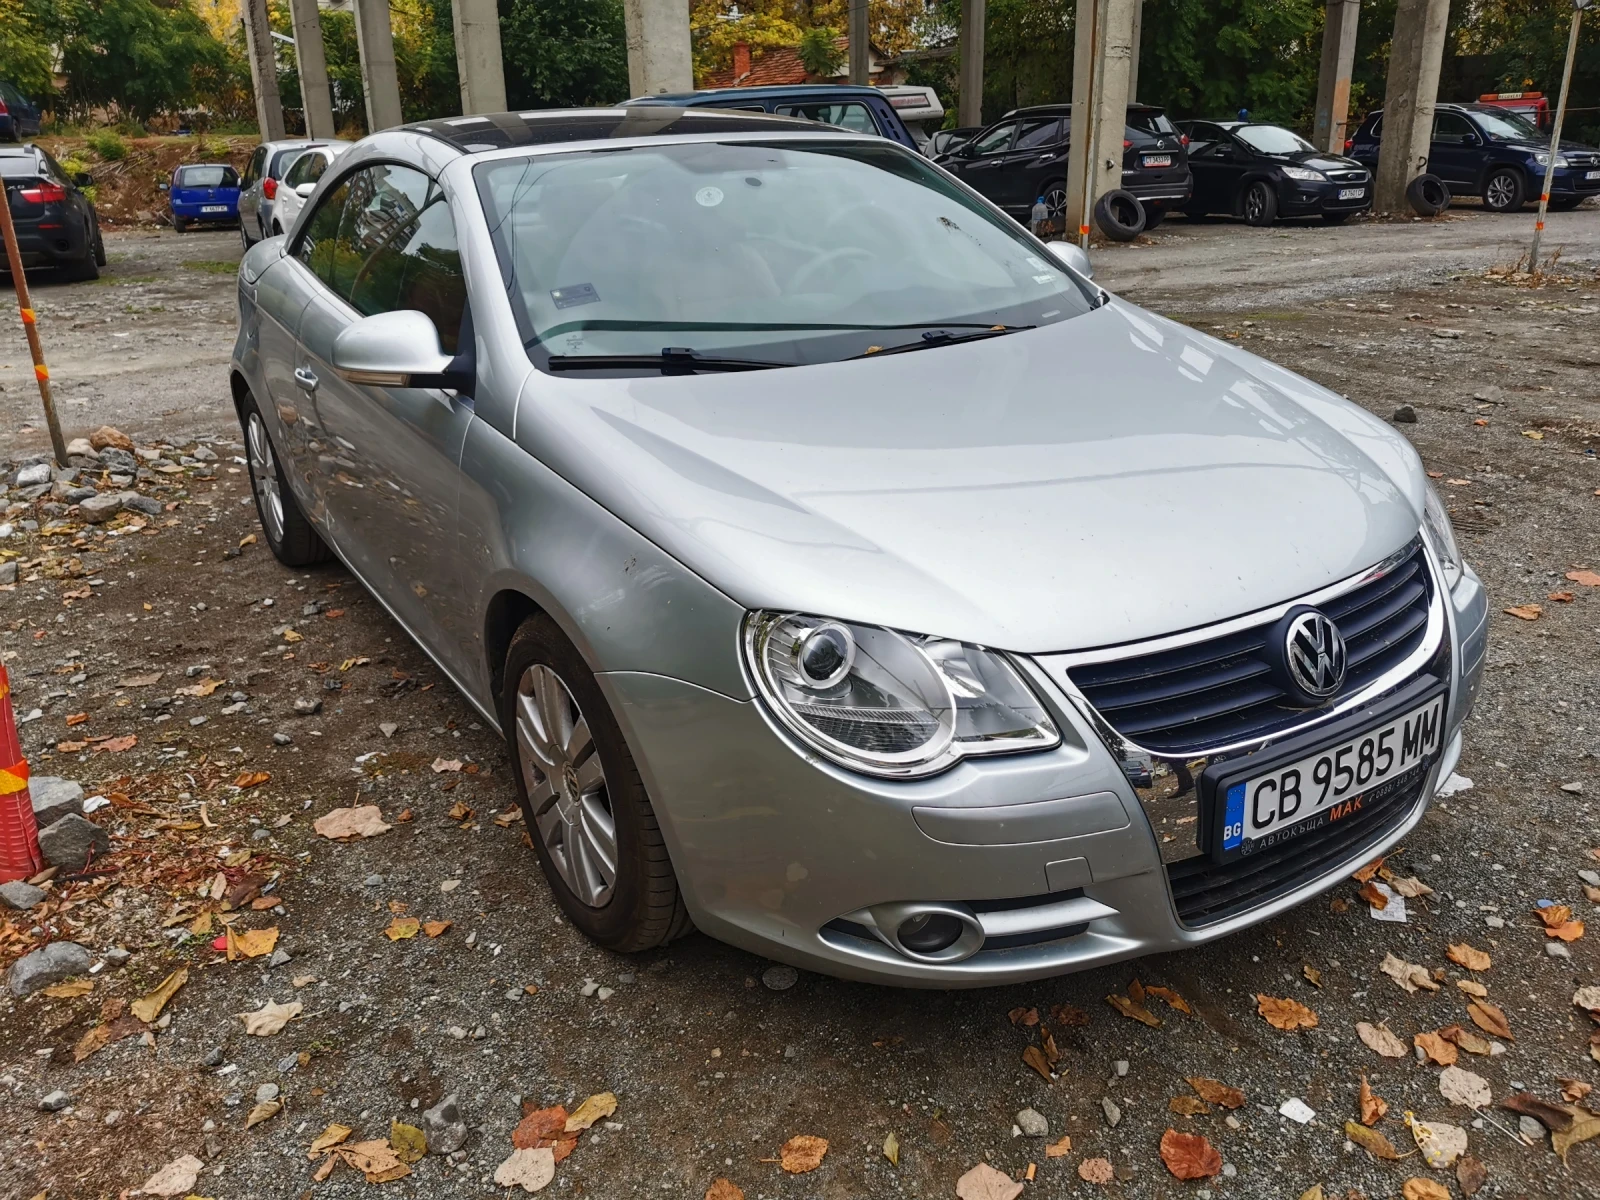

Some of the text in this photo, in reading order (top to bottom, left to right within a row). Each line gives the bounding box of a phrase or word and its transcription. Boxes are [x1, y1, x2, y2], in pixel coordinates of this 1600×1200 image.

[1145, 156, 1152, 164] CT
[1223, 703, 1439, 841] BG CB 9585 MM
[1259, 817, 1324, 849] АВТОКЪЩА
[1329, 794, 1364, 822] МАК
